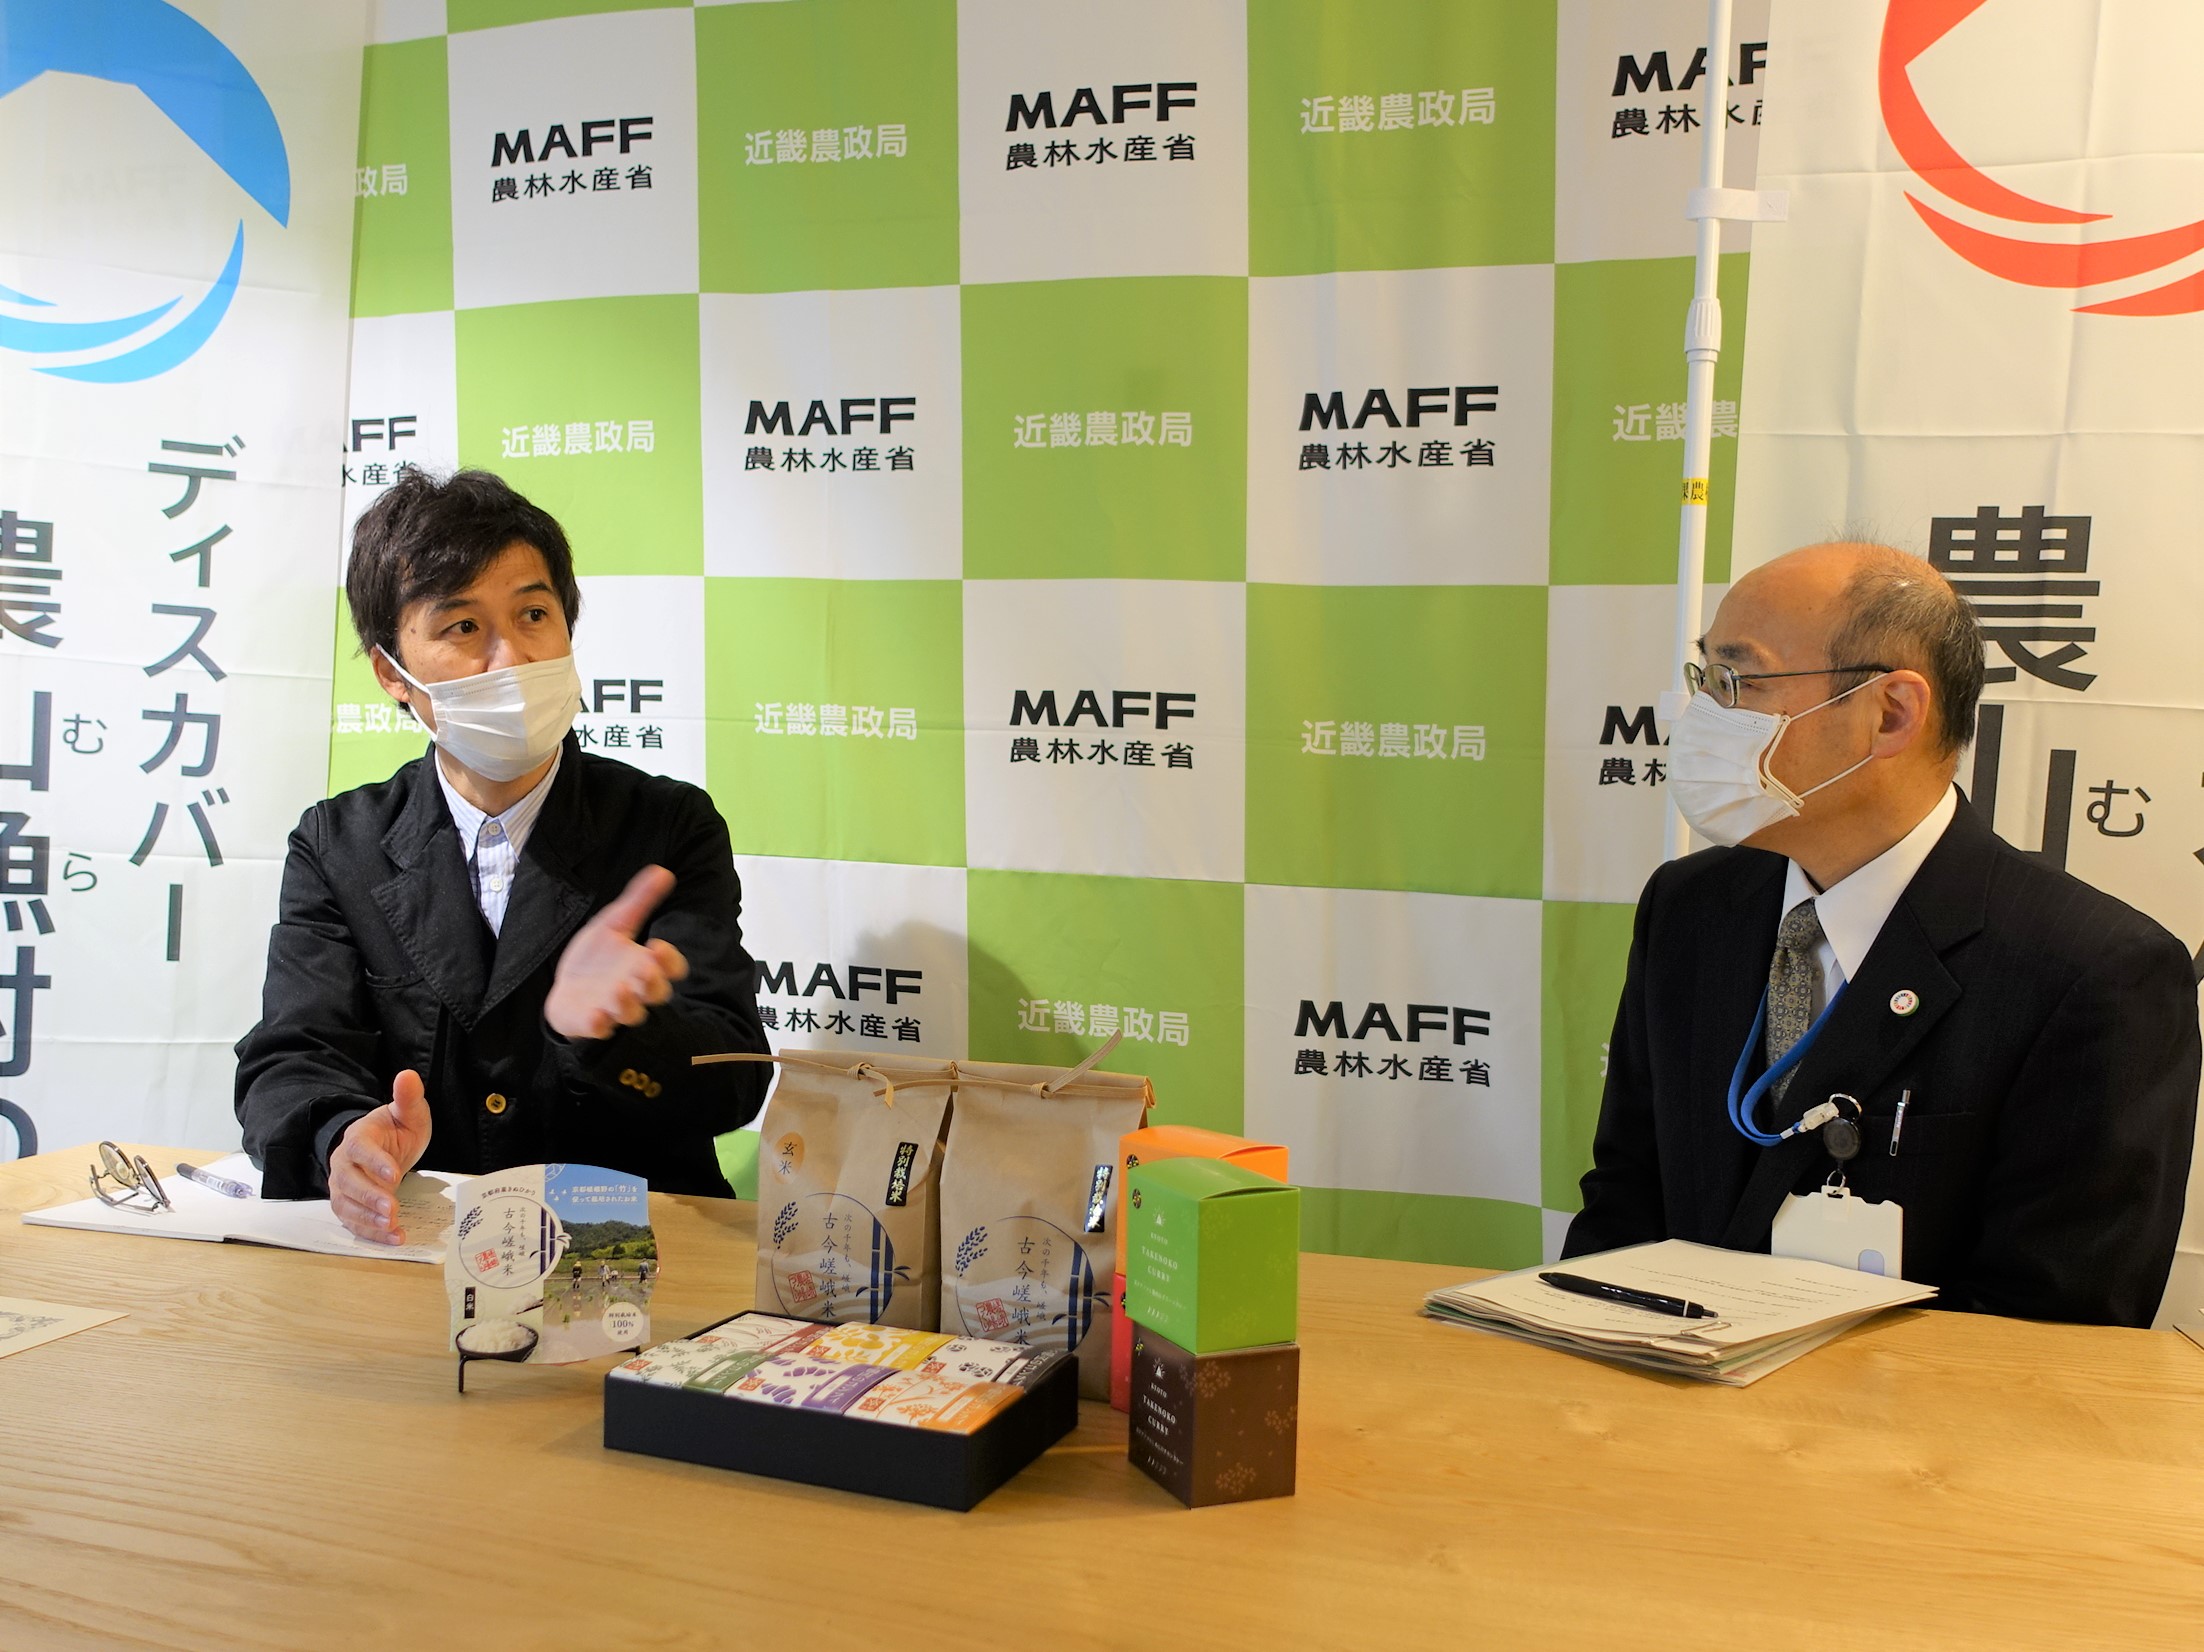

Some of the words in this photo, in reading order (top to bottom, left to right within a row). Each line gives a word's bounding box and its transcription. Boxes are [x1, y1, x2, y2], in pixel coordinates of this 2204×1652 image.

[1006, 82, 1197, 131] MAFF
[1300, 87, 1496, 134] 近畿農政局
[491, 117, 653, 167] MAFF
[744, 124, 908, 166] 近畿農政局
[1006, 133, 1196, 170] 農林水産省
[491, 165, 653, 203] 農林水産省
[744, 398, 916, 436] MAFF
[1299, 386, 1498, 430] MAFF
[502, 420, 654, 459] 近畿農政局
[1013, 411, 1193, 449] 近畿農政局
[744, 446, 915, 472] 農林水産省
[1299, 438, 1496, 470] 農林水産省
[130, 434, 246, 962] ディスカバー
[1009, 690, 1196, 730] MAFF
[62, 714, 107, 755] む
[754, 702, 917, 740] 近畿農政局
[1009, 738, 1194, 769] 農林水産省
[1301, 720, 1487, 762] 近畿農政局
[2087, 779, 2152, 837] む
[62, 852, 98, 892] ら
[754, 959, 923, 1005] MAFF
[1017, 998, 1190, 1047] 近畿農政局
[1294, 1000, 1491, 1046] MAFF
[1294, 1049, 1491, 1087] 農林水産省
[777, 1141, 798, 1175] 玄米
[819, 1212, 838, 1318] 古今嵯峨米
[1141, 1245, 1179, 1271] TAKENOKO
[1147, 1264, 1171, 1283] CURRY
[1142, 1394, 1176, 1424] TAKENOKO
[1147, 1415, 1170, 1436] CURRY
